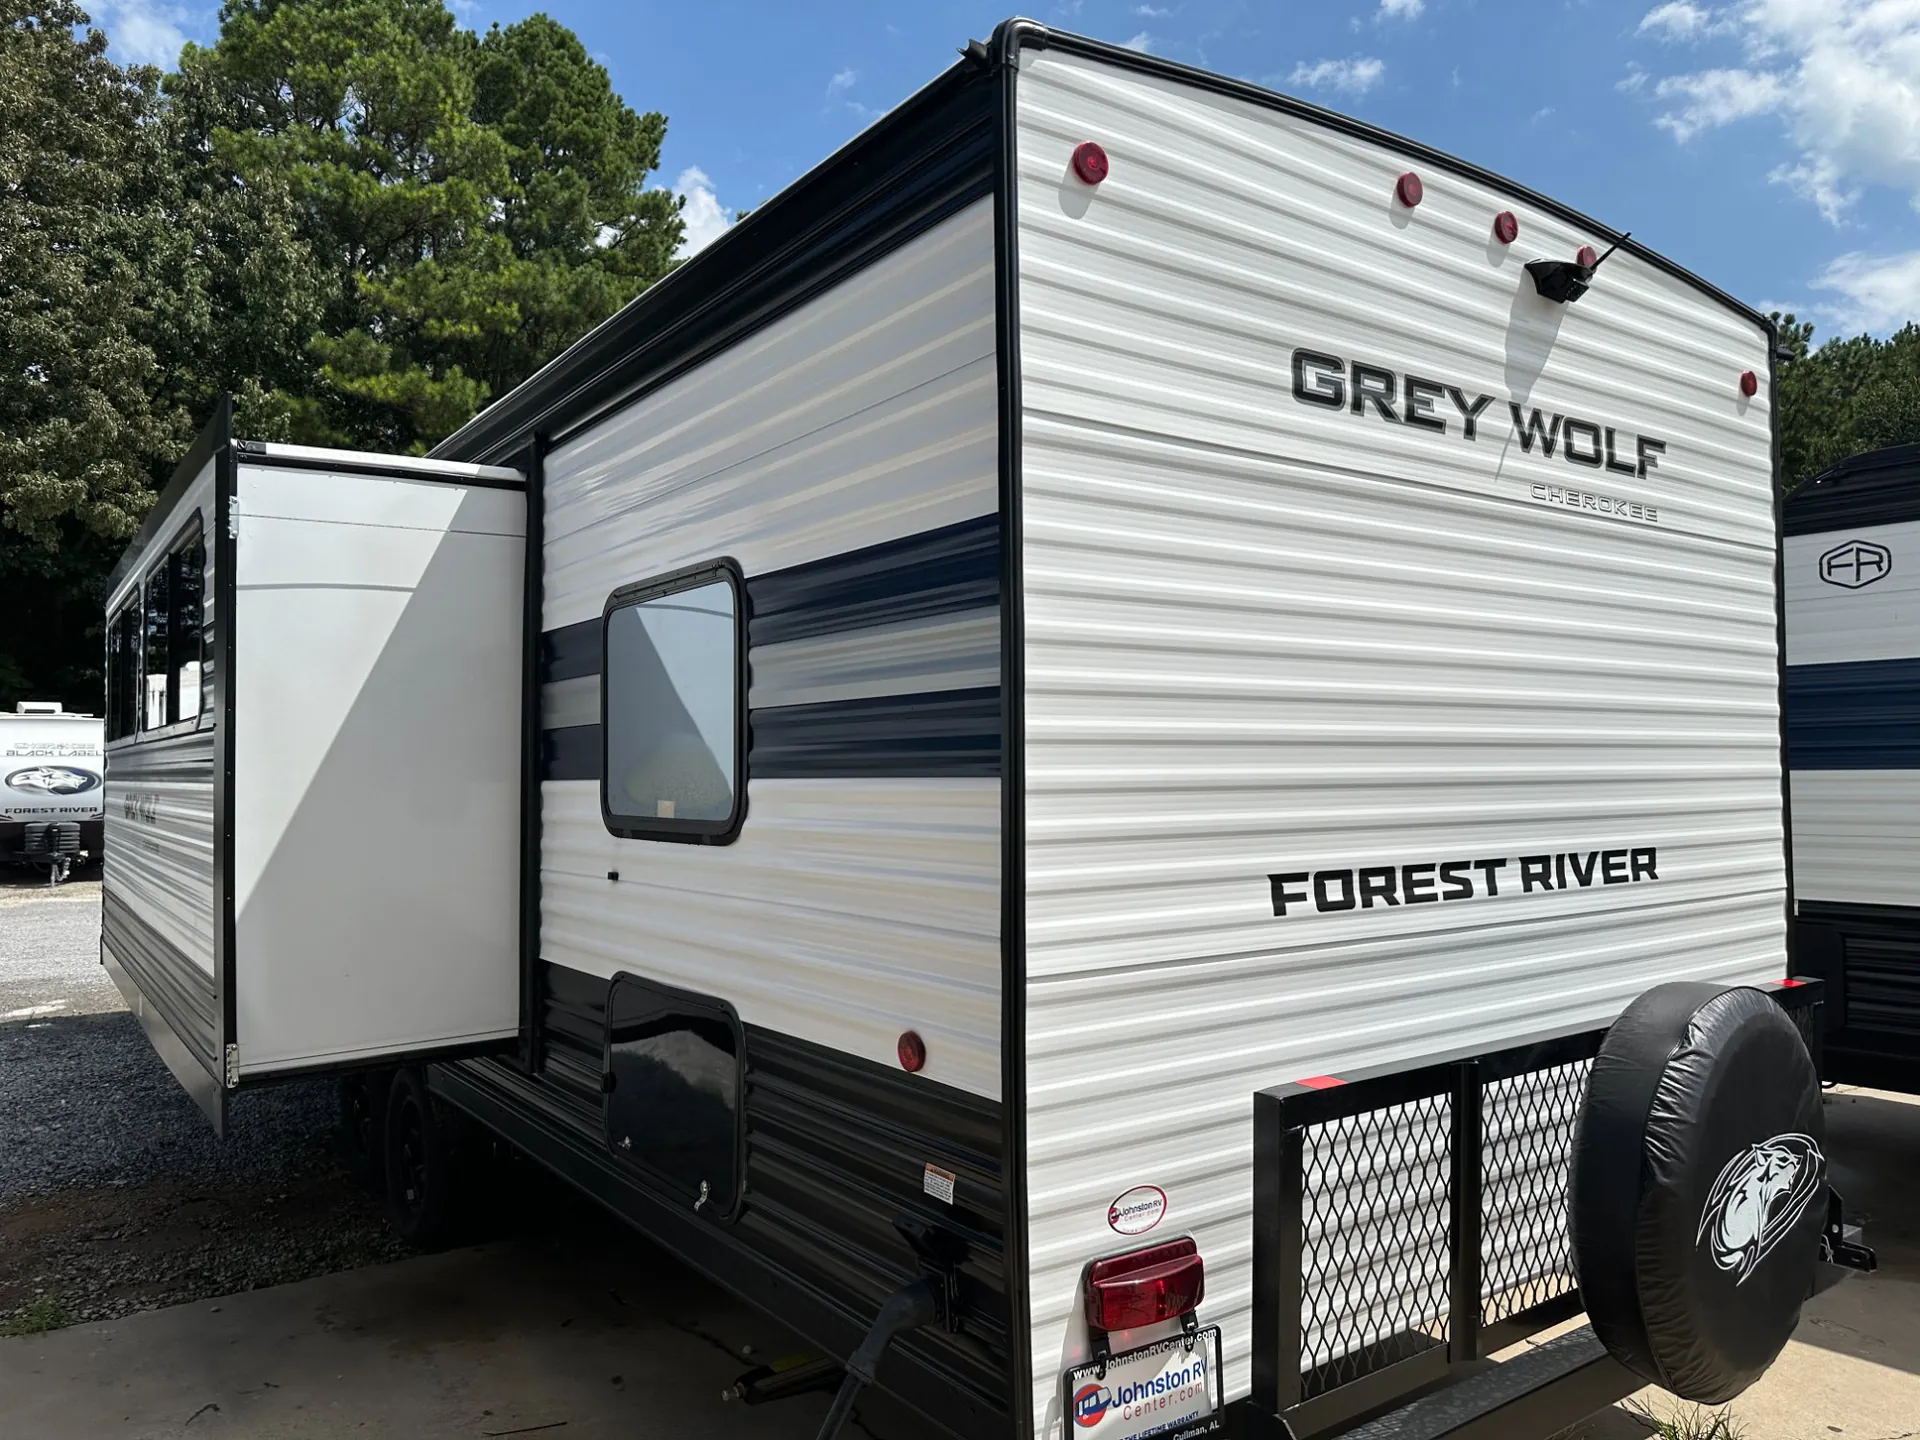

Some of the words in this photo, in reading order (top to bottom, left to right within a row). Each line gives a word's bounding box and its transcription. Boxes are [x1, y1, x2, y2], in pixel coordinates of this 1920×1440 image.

[1291, 347, 1496, 441] GREY
[1508, 401, 1667, 480] WOLF
[1530, 482, 1659, 523] CHEROKEE
[6, 749, 54, 757] BLACK
[59, 749, 103, 757] LABEL
[1266, 857, 1508, 917] FOREST
[1518, 847, 1660, 894] RIVER
[1121, 1202, 1153, 1217] Johnston
[1153, 1199, 1163, 1207] RV
[1112, 1368, 1190, 1409] Johnston
[1193, 1356, 1208, 1381] RV
[1123, 1382, 1203, 1421] Center.com
[1168, 1410, 1199, 1429] WARRANTY
[1209, 1420, 1220, 1431] AL
